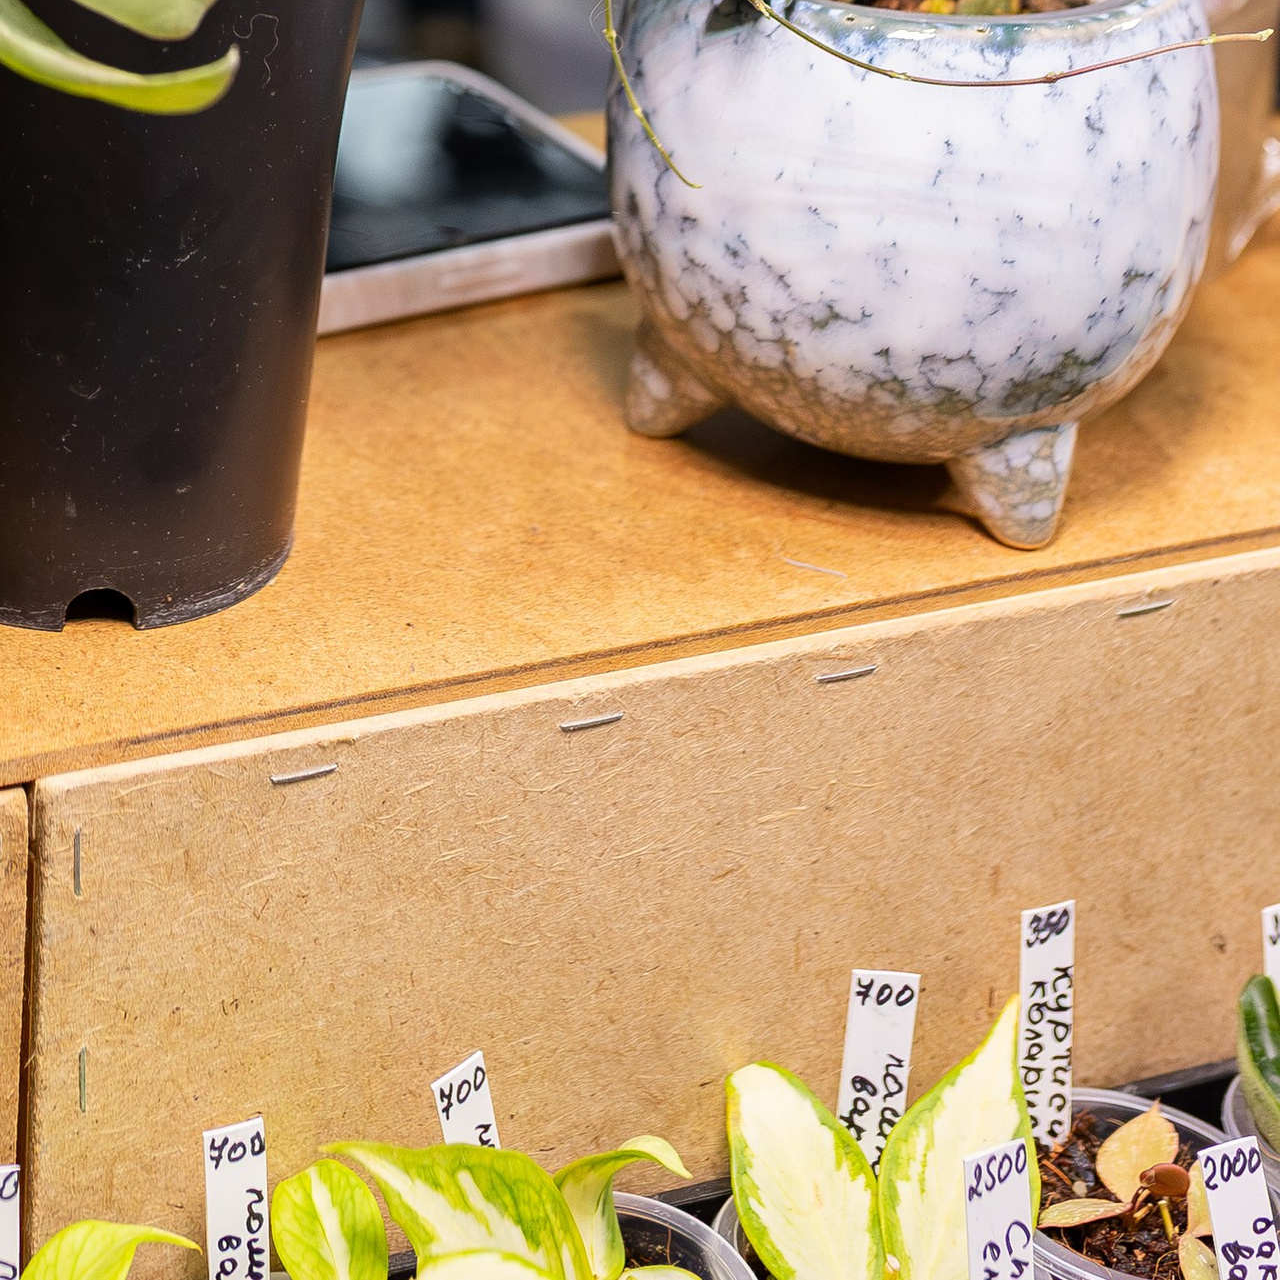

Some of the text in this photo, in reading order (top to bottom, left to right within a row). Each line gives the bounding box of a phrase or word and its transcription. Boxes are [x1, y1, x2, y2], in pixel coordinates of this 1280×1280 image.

[855, 977, 914, 1007] 700
[439, 1066, 486, 1121] 700
[209, 1130, 266, 1170] 700
[968, 1142, 1027, 1201] 2500
[1203, 1146, 1261, 1191] 2000
